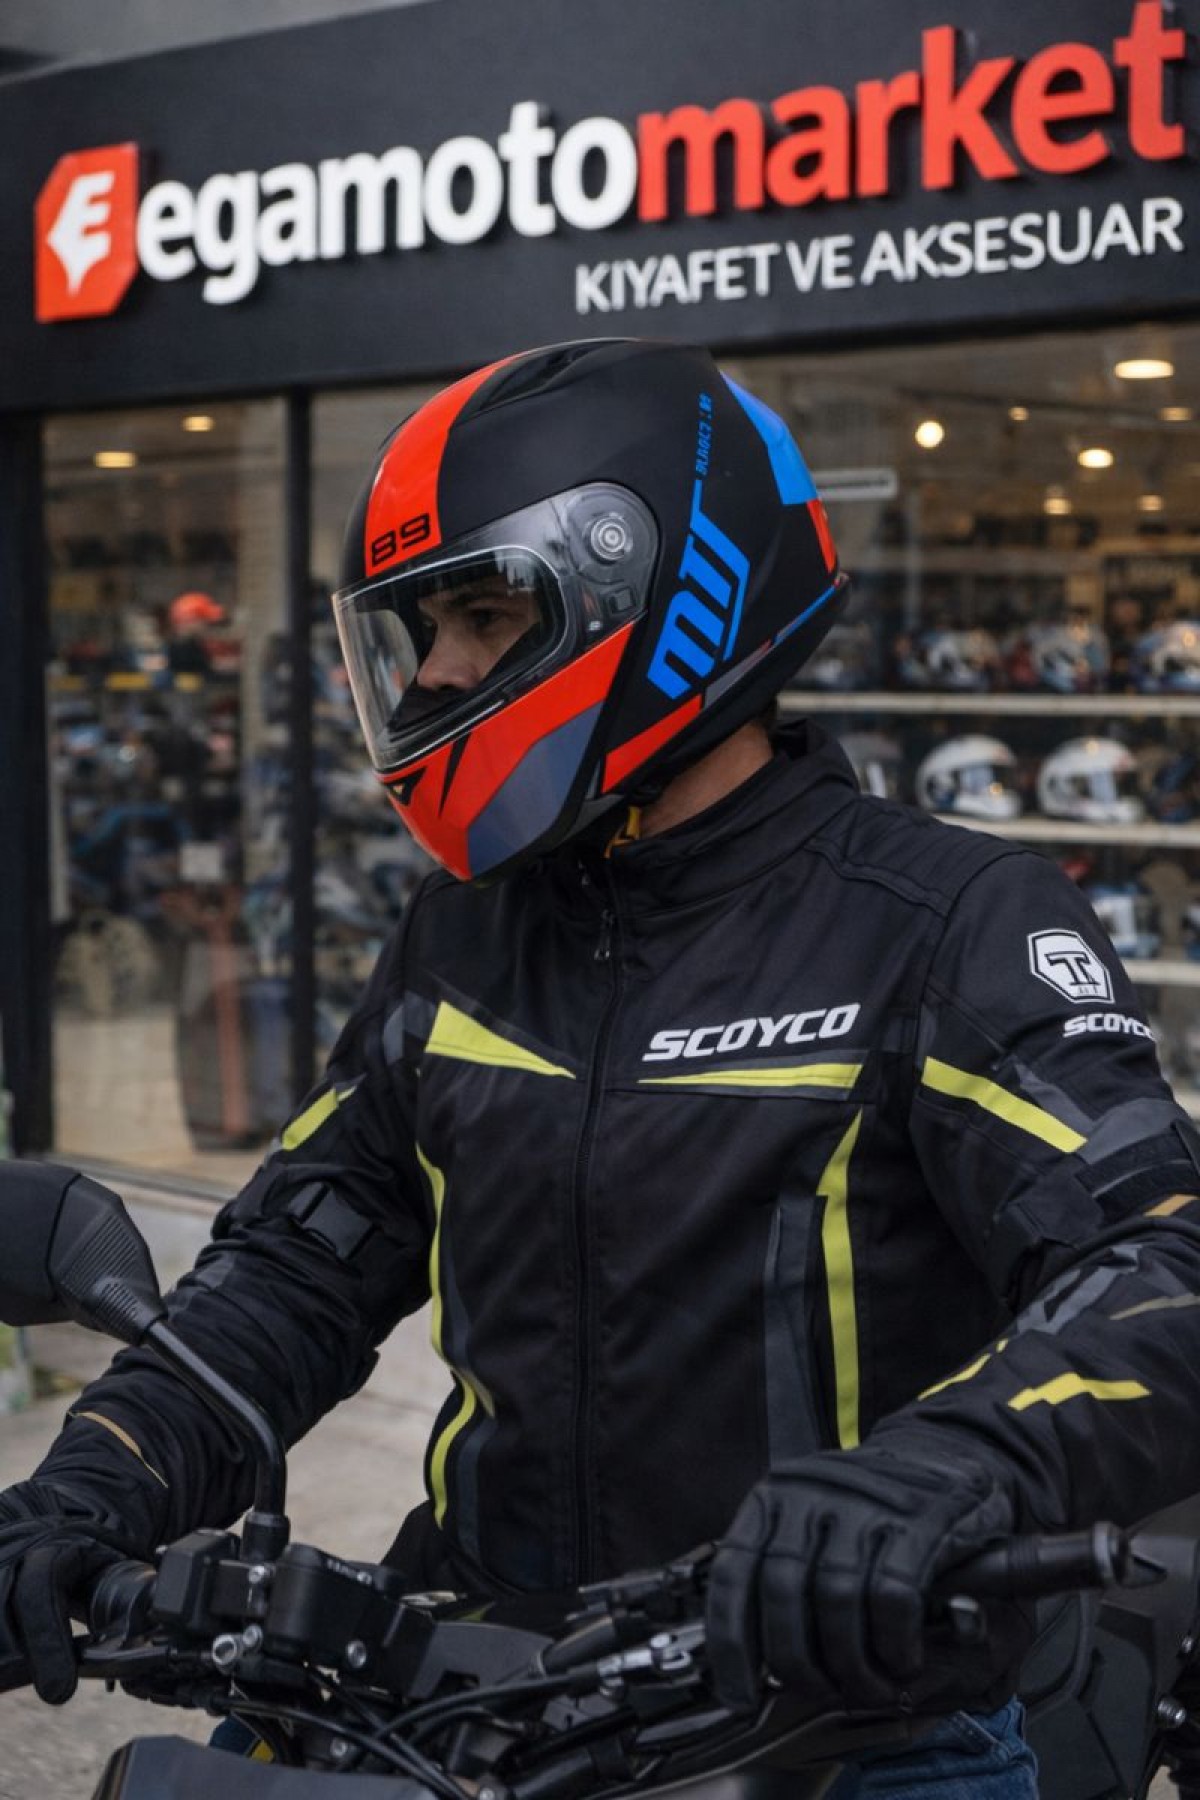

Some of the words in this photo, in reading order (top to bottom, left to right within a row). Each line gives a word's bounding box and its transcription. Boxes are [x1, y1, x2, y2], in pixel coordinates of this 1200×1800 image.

[575, 243, 780, 313] KIYAFET
[786, 235, 854, 291] VE
[861, 197, 1185, 285] AKSESUAR
[641, 1002, 862, 1062] SCOYCO
